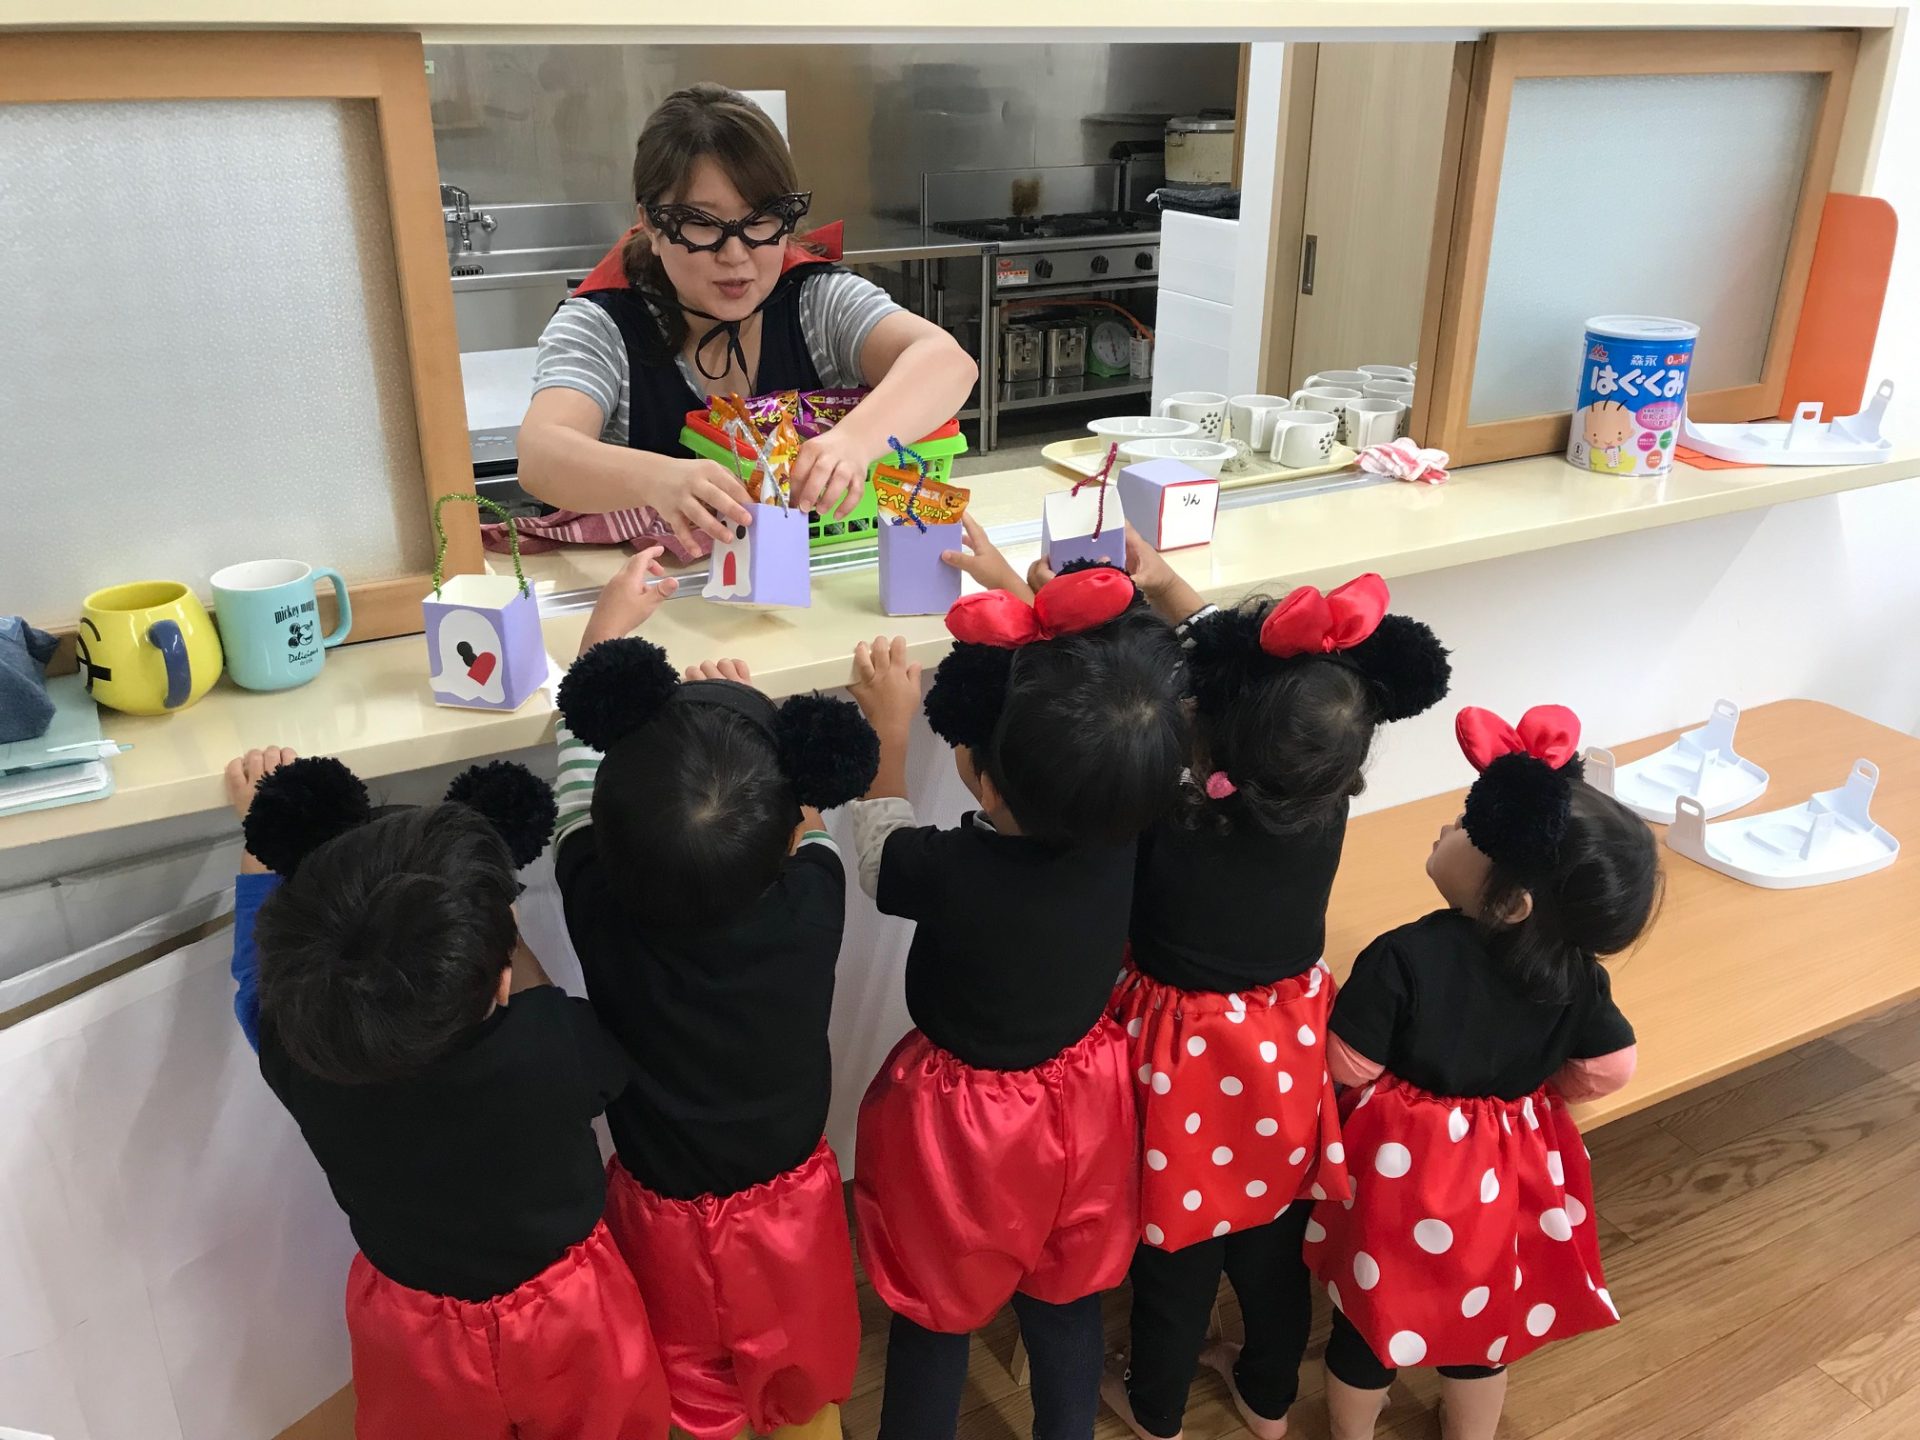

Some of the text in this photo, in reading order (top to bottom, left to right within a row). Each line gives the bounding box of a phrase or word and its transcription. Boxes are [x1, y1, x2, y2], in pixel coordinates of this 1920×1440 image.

[1630, 354, 1658, 367] 森永
[1591, 365, 1684, 397] はぐくみ
[1182, 492, 1200, 506] りん
